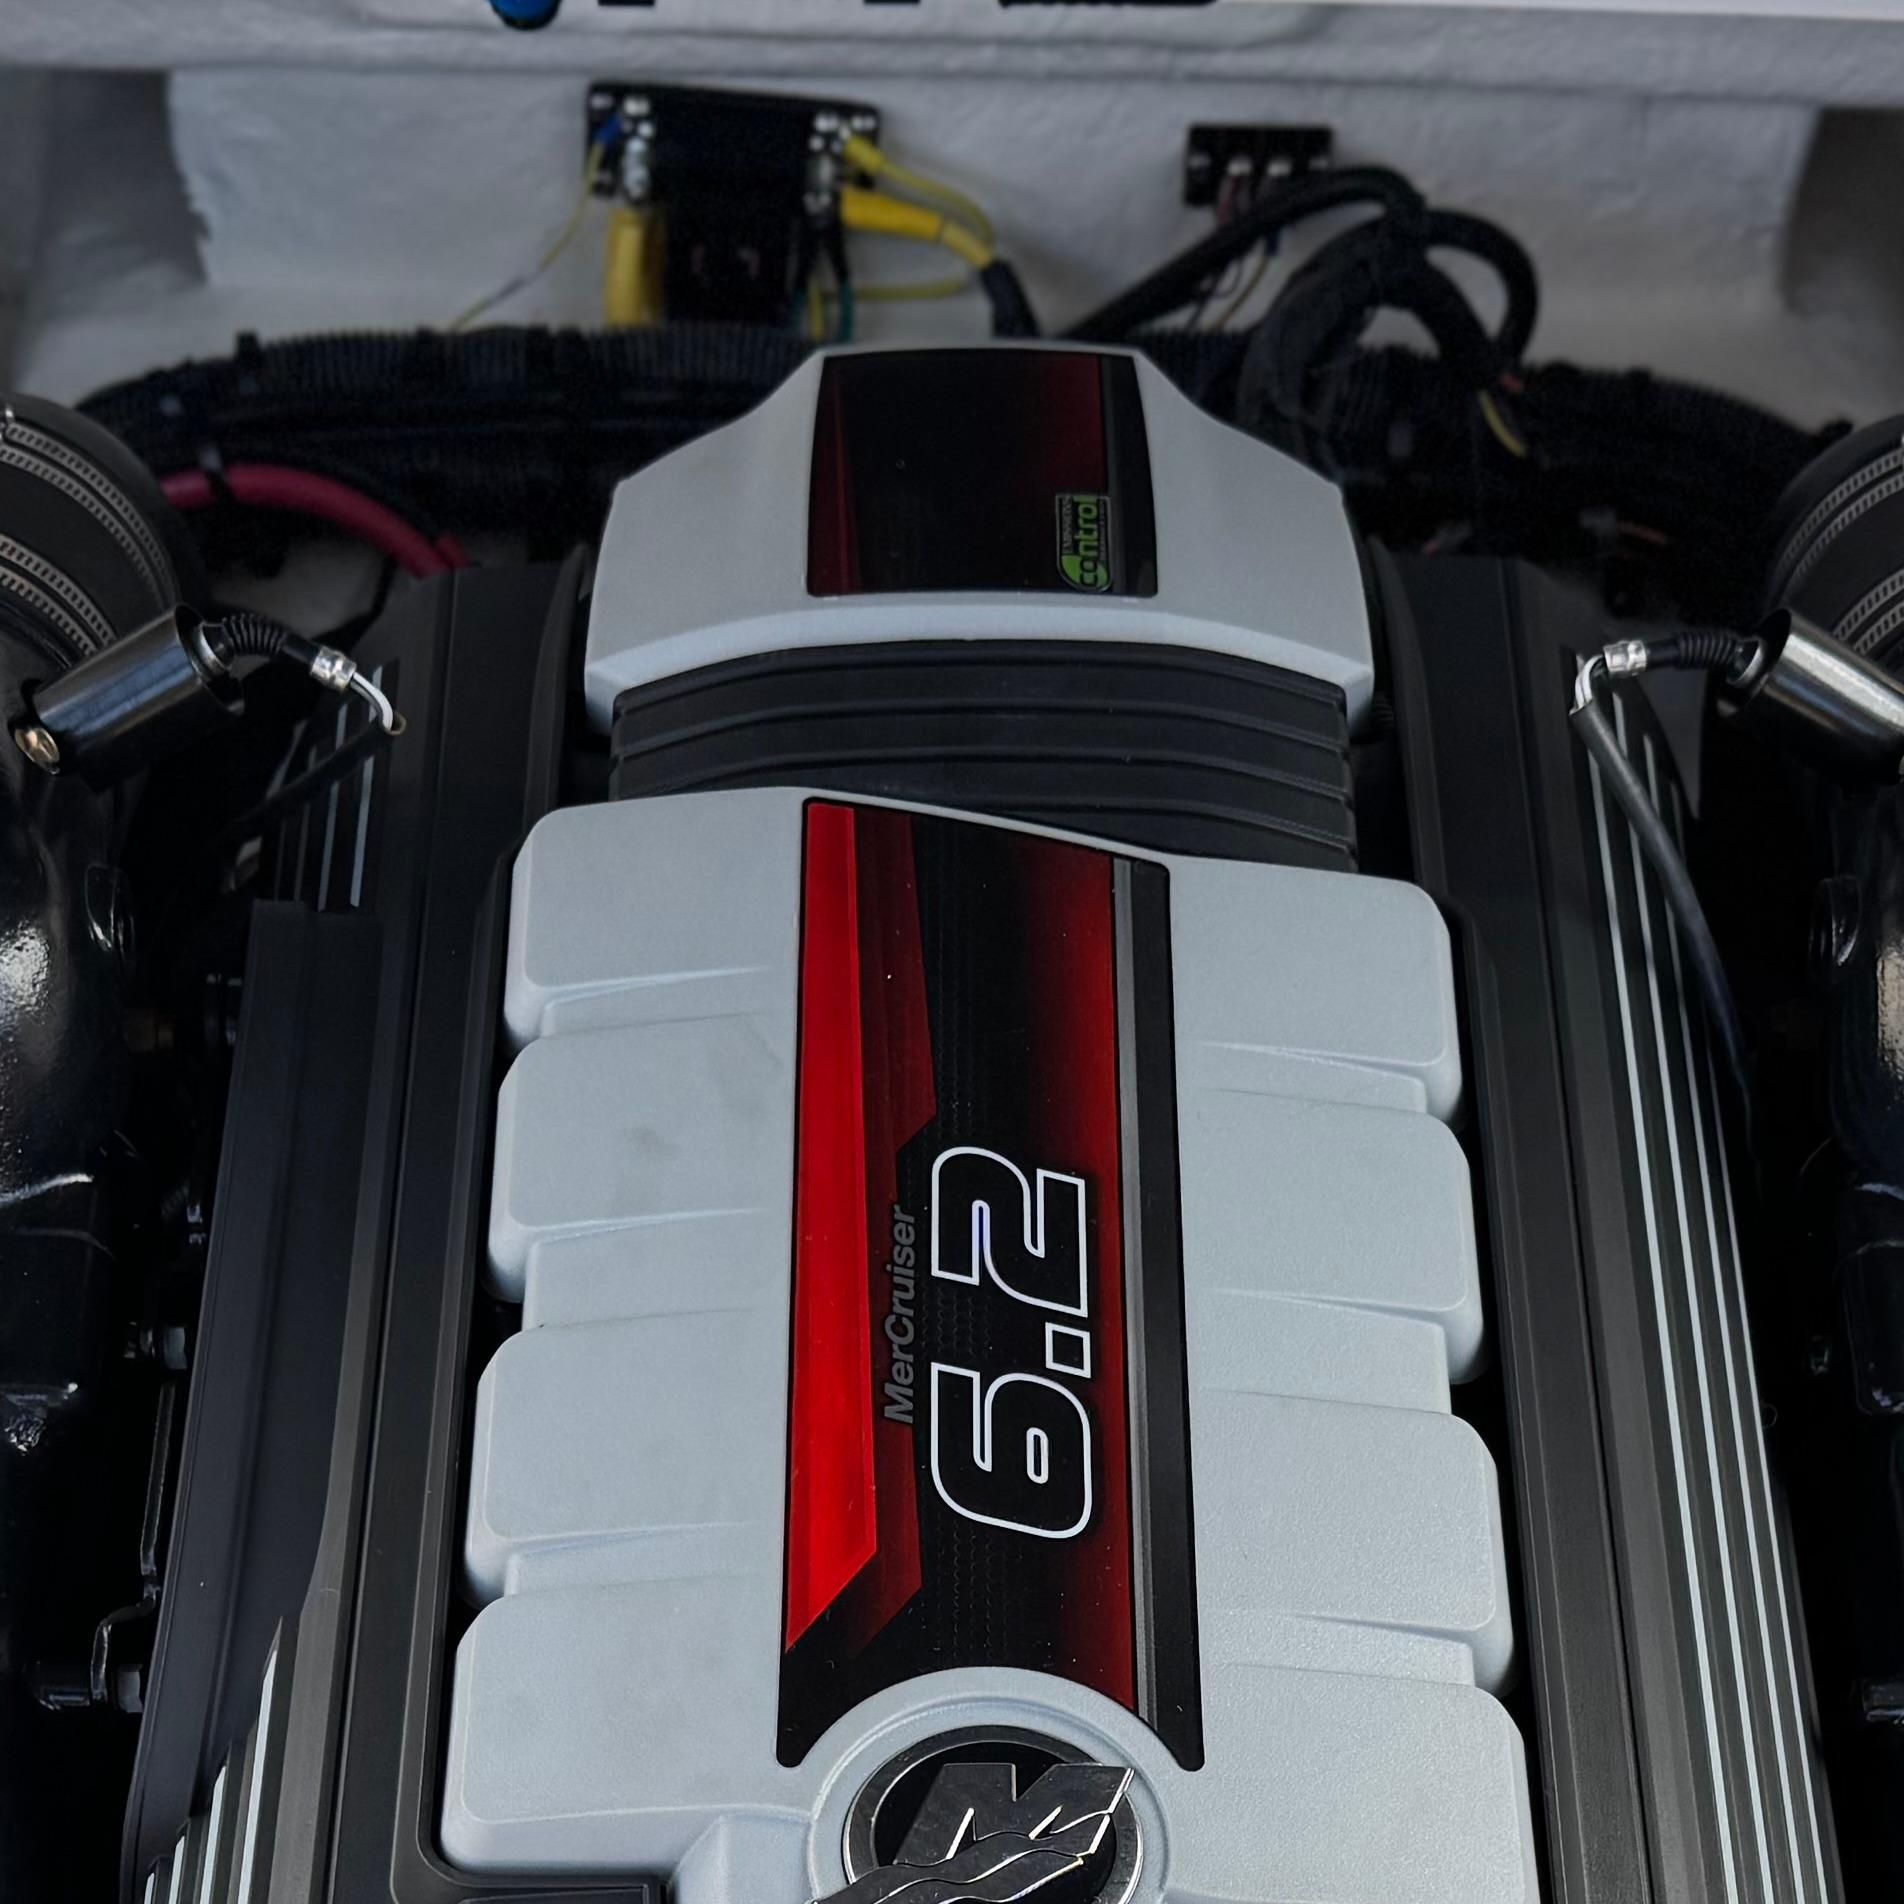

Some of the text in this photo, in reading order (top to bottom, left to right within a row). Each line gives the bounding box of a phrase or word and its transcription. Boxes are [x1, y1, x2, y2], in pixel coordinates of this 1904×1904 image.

[1073, 495, 1098, 586] control
[884, 1205, 915, 1424] MerCruiser
[930, 1146, 1092, 1539] 6.2
